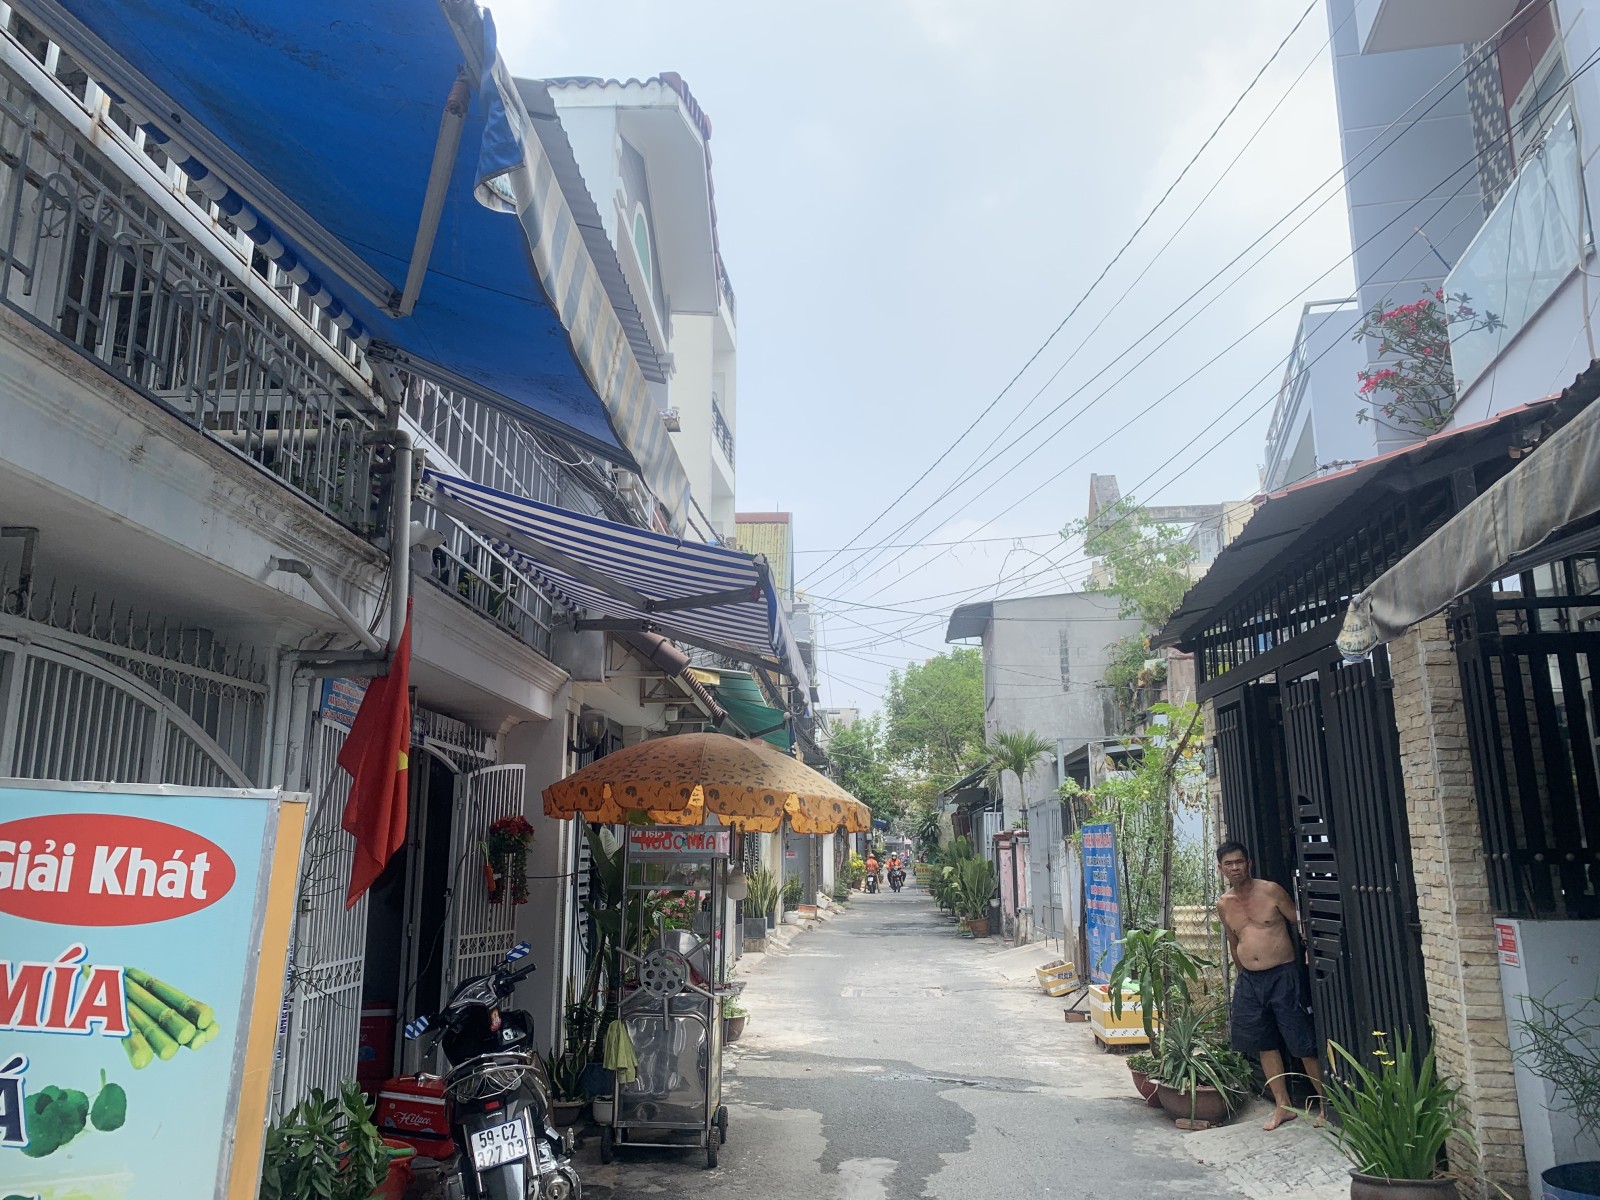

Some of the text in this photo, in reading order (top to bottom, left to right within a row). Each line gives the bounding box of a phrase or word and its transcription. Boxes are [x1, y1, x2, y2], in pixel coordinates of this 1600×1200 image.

[0, 840, 211, 900] Giải Khát
[0, 943, 130, 1035] MÍA
